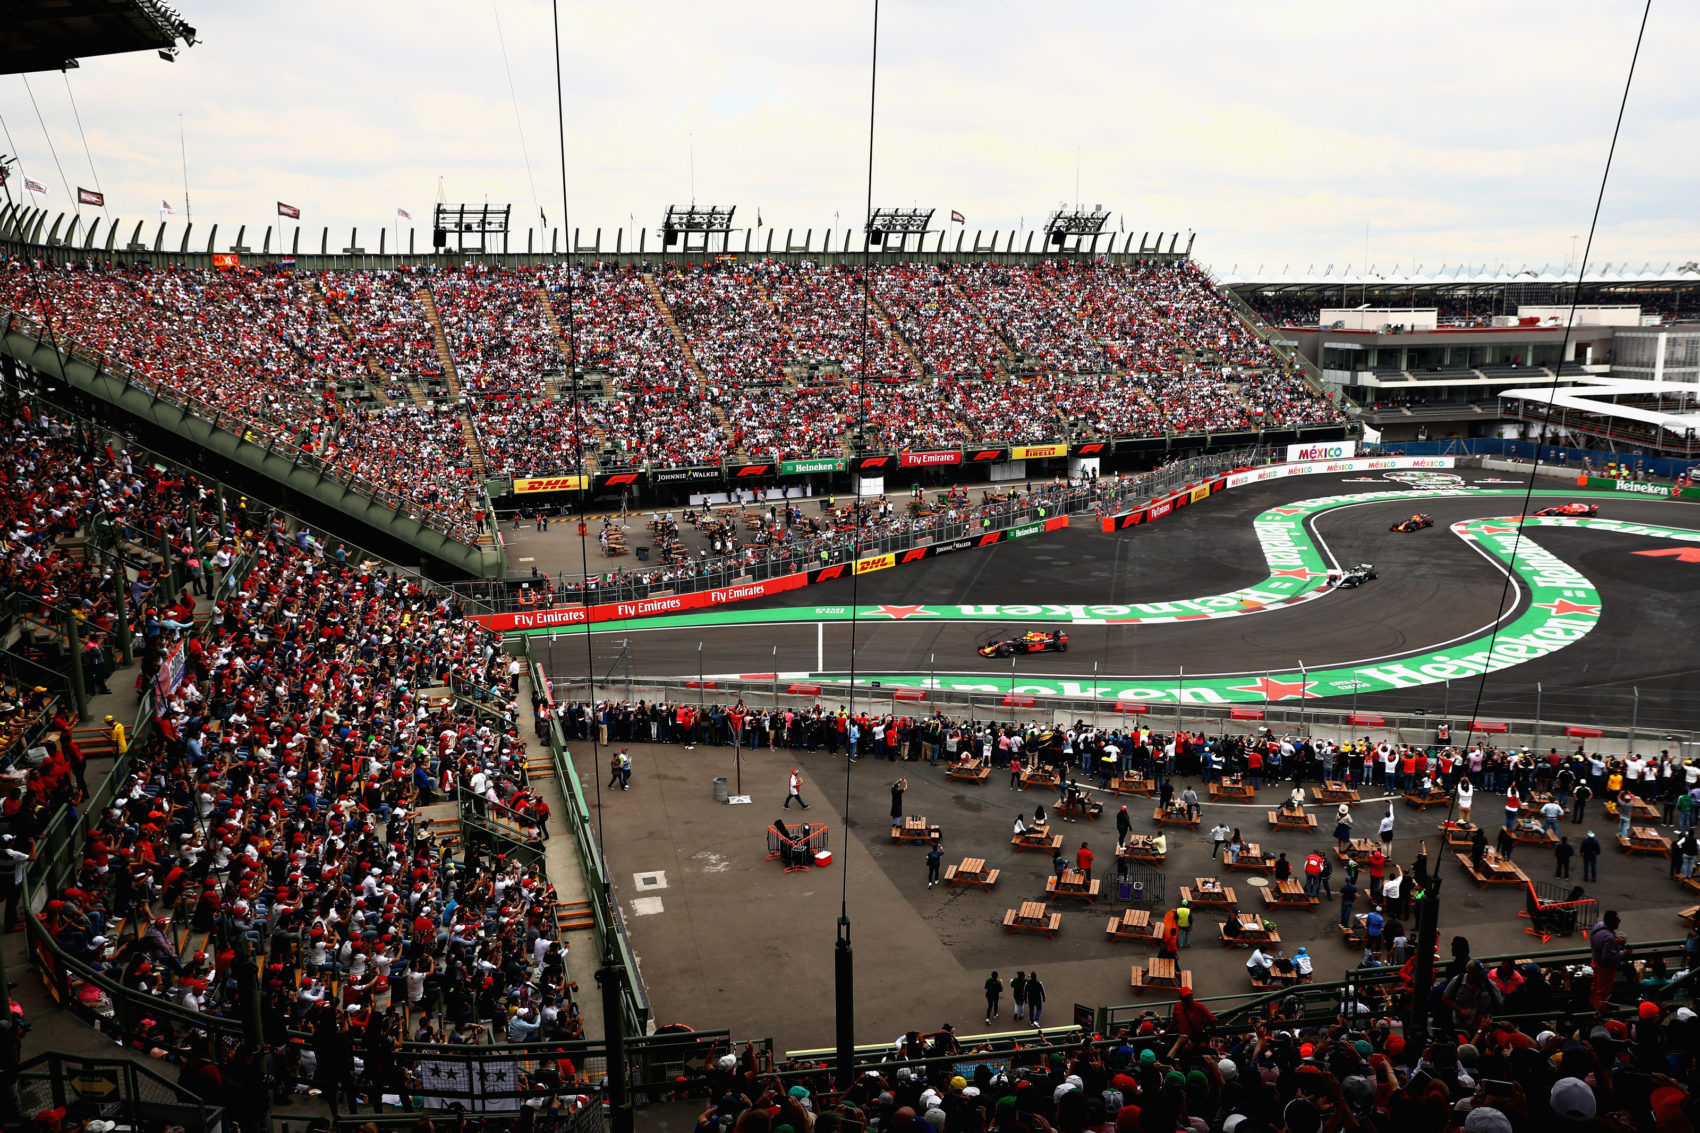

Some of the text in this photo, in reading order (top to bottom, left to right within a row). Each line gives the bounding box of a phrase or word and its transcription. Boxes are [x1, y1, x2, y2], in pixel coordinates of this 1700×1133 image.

[909, 453, 955, 465] Fly Emirates
[795, 462, 833, 473] Heineken
[657, 471, 719, 482] JOHNNIE WALKER
[527, 479, 572, 491] DHL
[1616, 479, 1668, 496] Heineken
[1015, 526, 1039, 538] Heineken
[859, 557, 888, 571] DHL
[711, 584, 765, 602] Fly Emirates
[617, 598, 681, 616] Fly Emirates
[513, 610, 585, 626] Fly Emirates
[1354, 618, 1598, 689] Heineken
